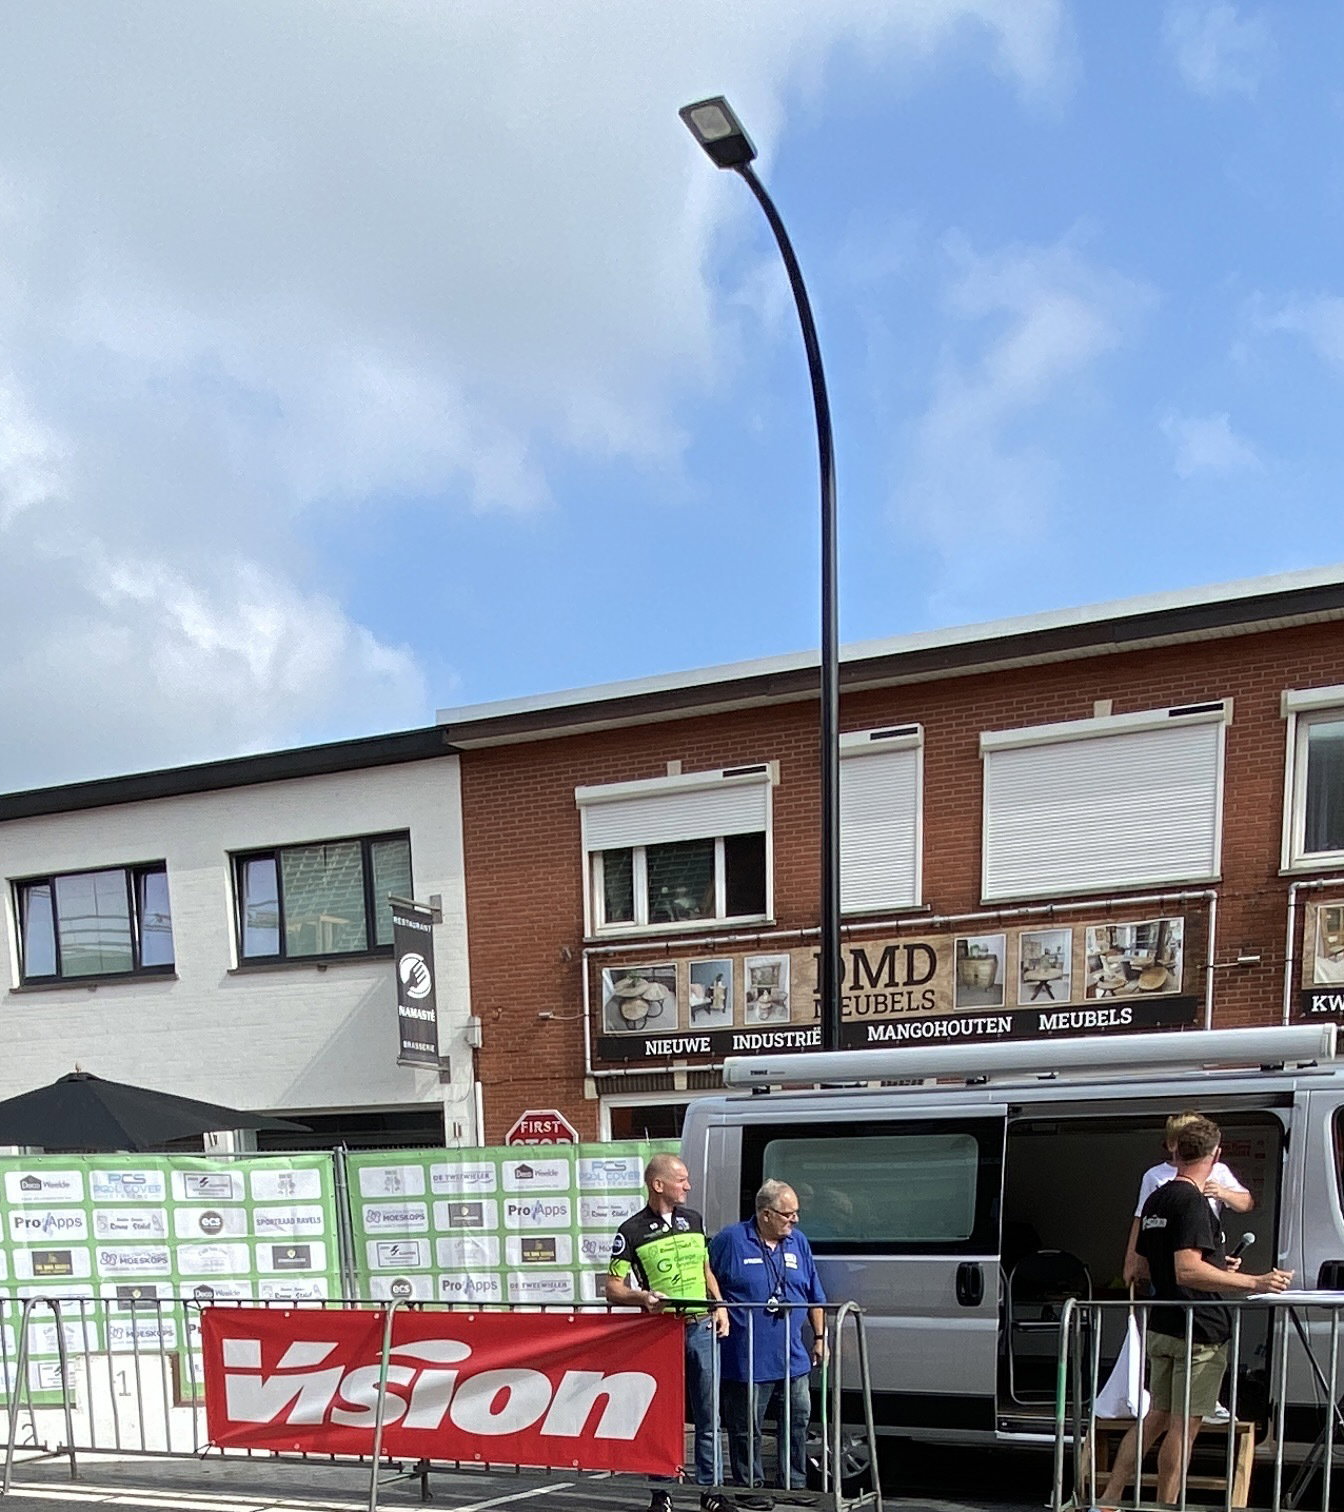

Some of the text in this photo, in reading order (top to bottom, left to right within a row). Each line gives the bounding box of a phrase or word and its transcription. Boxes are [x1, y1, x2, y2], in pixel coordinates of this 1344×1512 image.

[813, 989, 936, 1019] EUBELS
[645, 1007, 1133, 1056] NIEUWE INDUSTRIË MANGOHOUTEN MEUBELS
[521, 1121, 561, 1134] FIRST
[591, 1160, 627, 1171] PCS
[108, 1173, 146, 1184] PCS
[508, 1204, 531, 1216] Pro
[14, 1216, 41, 1228] Pro
[392, 1284, 411, 1293] ecs
[442, 1280, 462, 1291] Pro
[116, 1370, 131, 1396] 1
[222, 1338, 657, 1441] Vision
